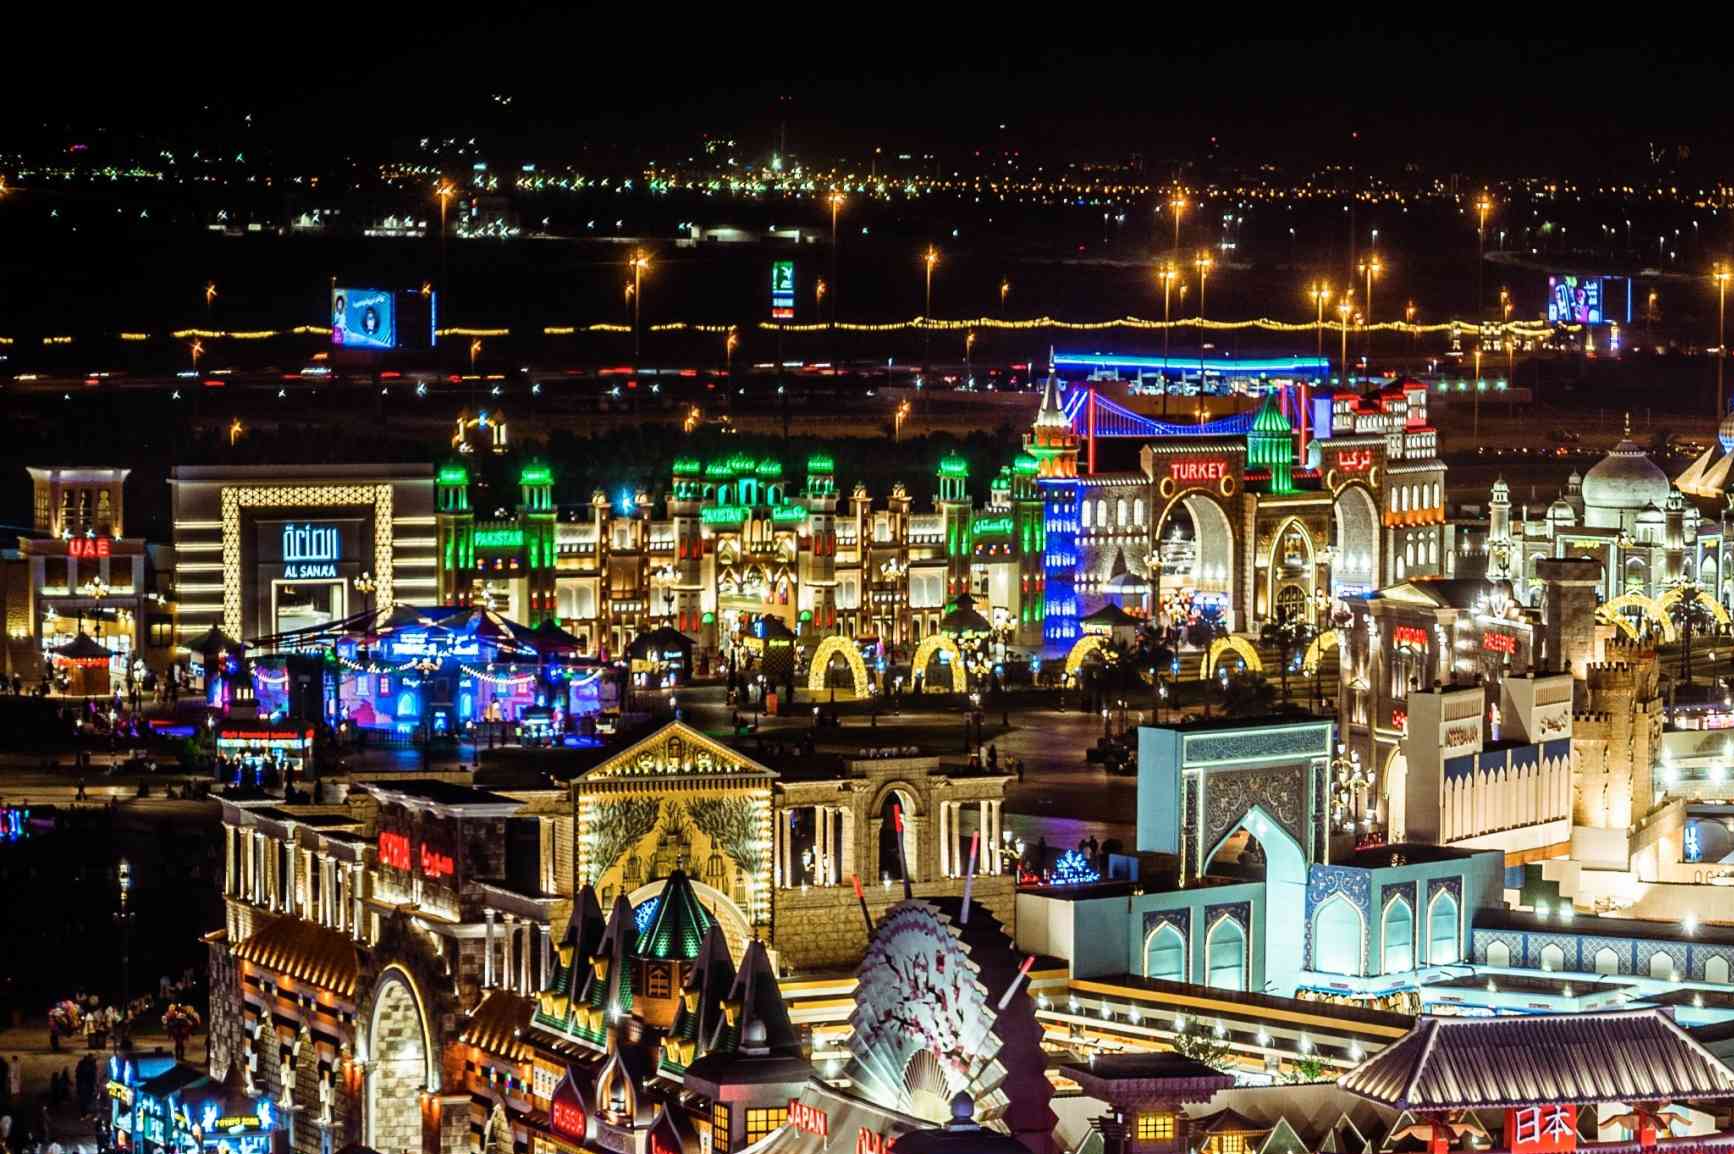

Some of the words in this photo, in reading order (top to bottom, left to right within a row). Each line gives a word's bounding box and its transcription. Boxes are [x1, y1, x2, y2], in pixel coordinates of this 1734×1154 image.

[1337, 450, 1371, 472] تركيا
[1170, 463, 1225, 480] TURKEY
[69, 538, 111, 557] UAE
[284, 565, 298, 578] AL
[789, 1099, 829, 1137] JAPAN
[1515, 1103, 1575, 1146] 日本
